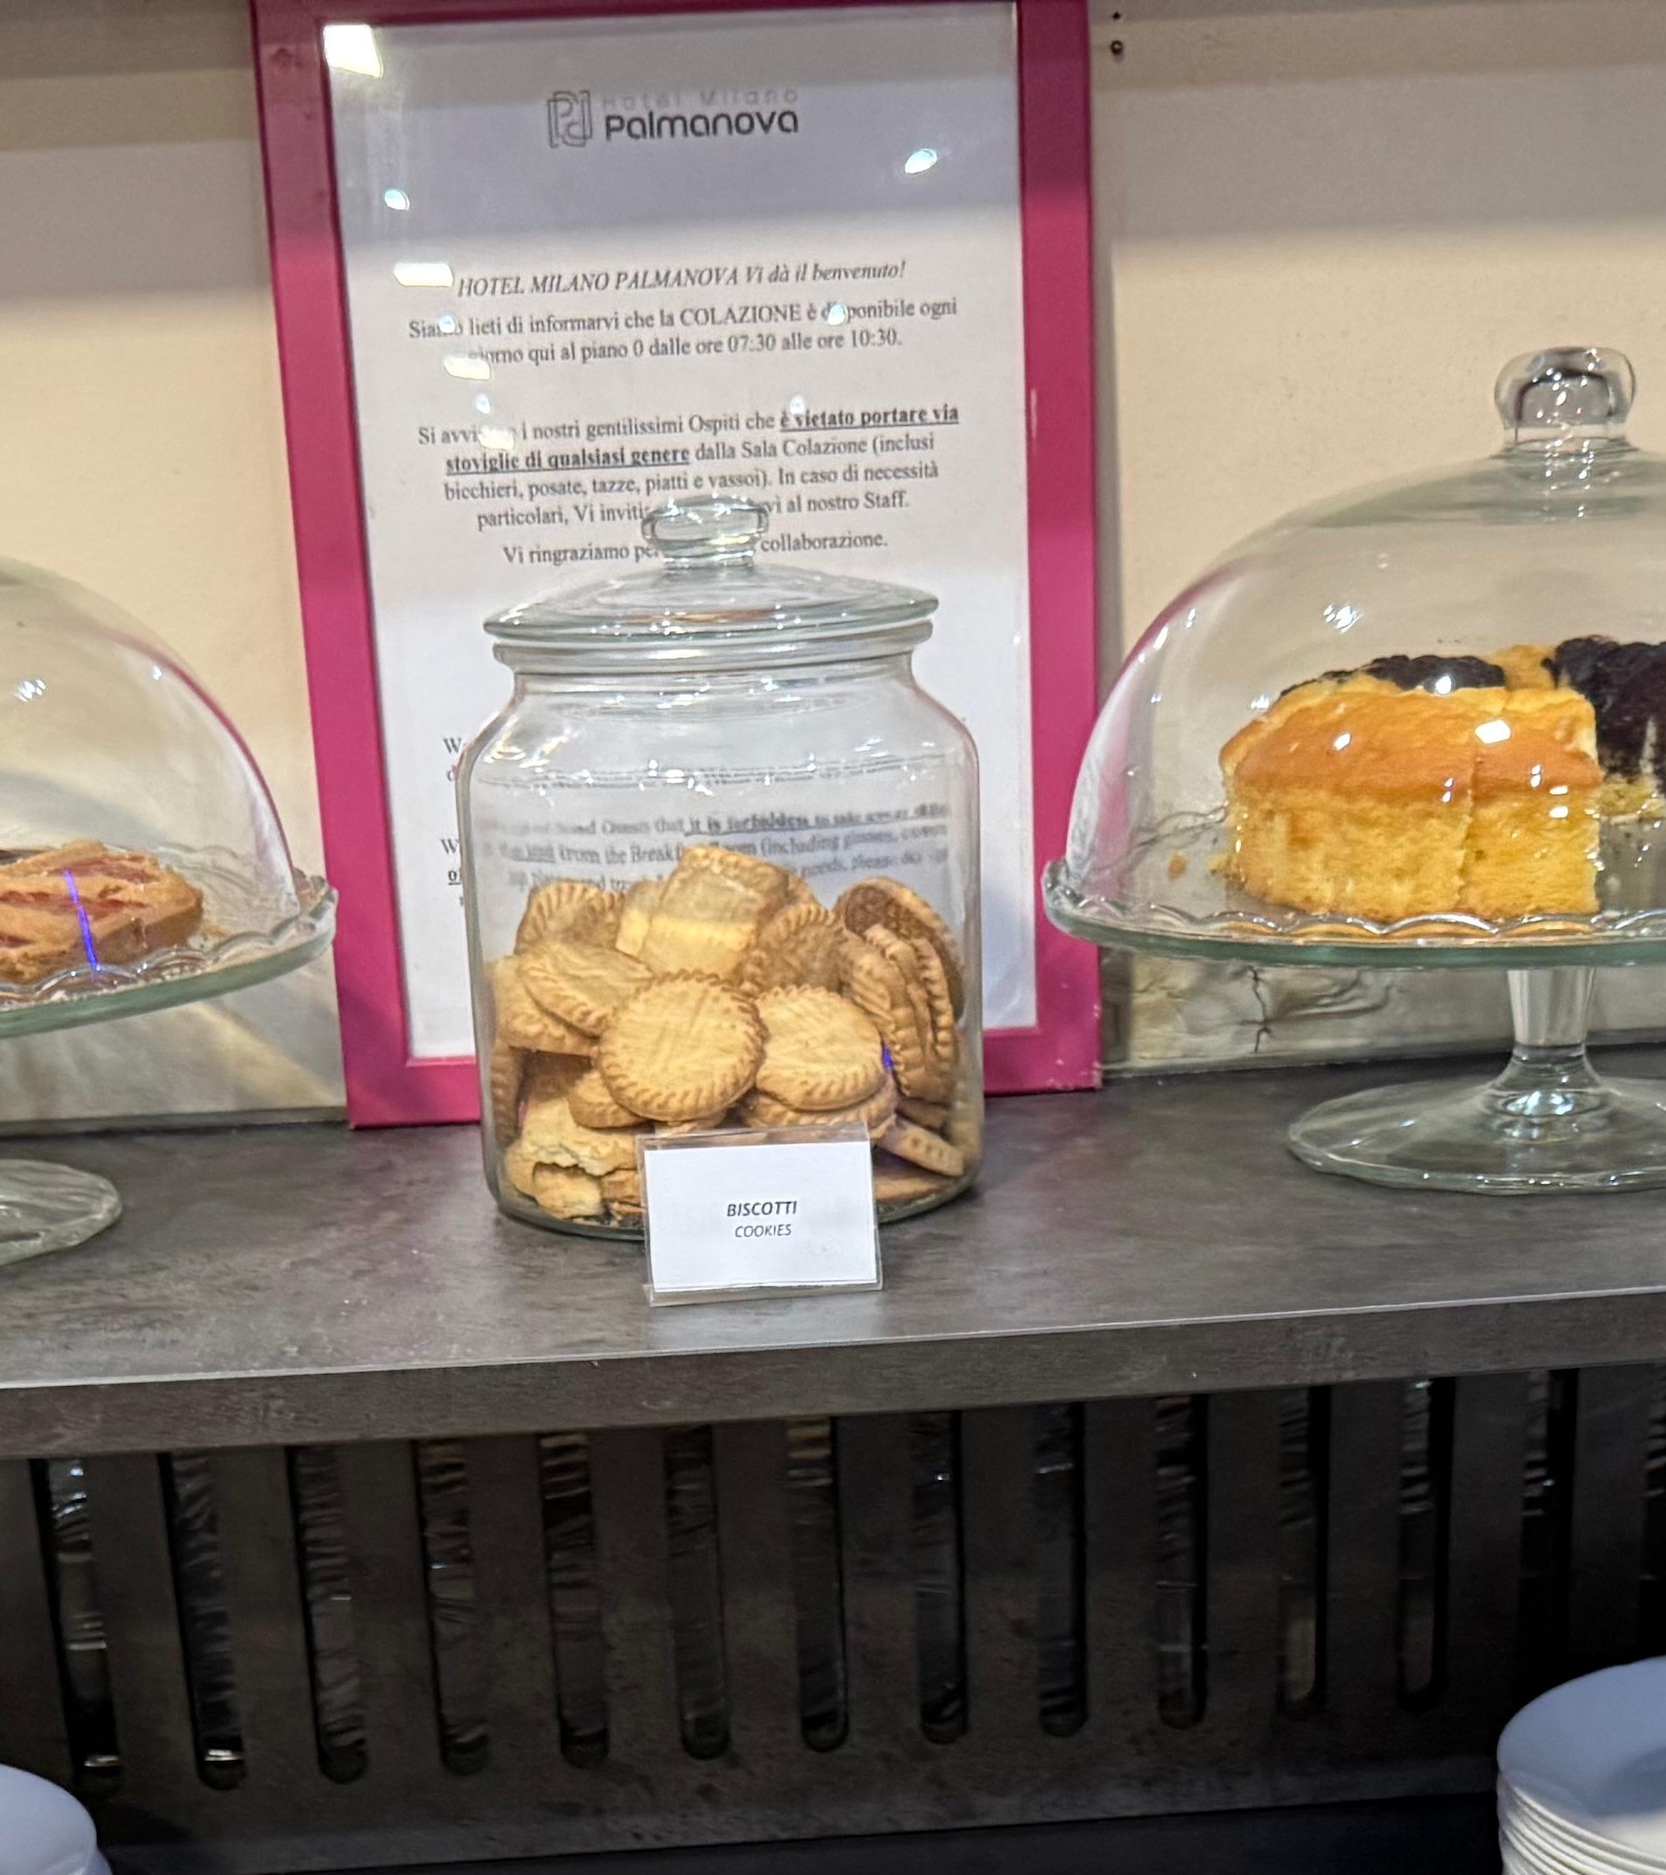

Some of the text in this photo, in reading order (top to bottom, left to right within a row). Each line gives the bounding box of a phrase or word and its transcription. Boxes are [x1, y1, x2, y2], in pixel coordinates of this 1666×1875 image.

[605, 110, 799, 141] Palmanova
[458, 260, 907, 298] HOTEL MILANO PALMANOVA Vi dà il benvenuto!
[469, 316, 502, 336] lieti
[508, 315, 524, 334] di
[530, 311, 620, 334] informarvi
[625, 310, 655, 330] che
[660, 309, 676, 328] la
[680, 303, 802, 327] COLAZIONE
[807, 303, 817, 321] è
[920, 297, 958, 320] ogni
[529, 342, 556, 366] qui
[561, 341, 576, 361] al
[582, 340, 629, 364] piano
[633, 339, 644, 358] 0
[649, 336, 691, 357] dalle
[696, 338, 723, 355] ore
[727, 333, 777, 354] 07:30
[782, 331, 812, 351] alle
[818, 333, 845, 349] ore
[851, 328, 903, 349] 10:30.
[418, 426, 436, 445] Si
[522, 421, 528, 440] i
[533, 419, 581, 440] nostri
[585, 414, 684, 442] gentilissimi
[688, 411, 741, 435] Ospiti
[746, 410, 775, 430] che
[780, 411, 791, 431] è
[795, 408, 855, 429] vietato
[861, 406, 929, 428] portare
[933, 403, 960, 425] via
[446, 431, 935, 474] stoviglie di qualsiasi genere dalla Sala Colazione (inclusi
[444, 460, 939, 502] bicchieri, posate, tazze, piatti e vassoi). In caso di necessità
[477, 507, 569, 532] particolari,
[574, 504, 594, 523] Vi
[786, 494, 802, 514] al
[807, 494, 859, 513] nostro
[864, 490, 910, 510] Staff.
[503, 545, 525, 564] Vi
[529, 542, 630, 567] ringraziamo
[760, 530, 889, 553] collaborazione.
[726, 1200, 798, 1218] BISCOTTI
[734, 1223, 793, 1238] COOKIES
